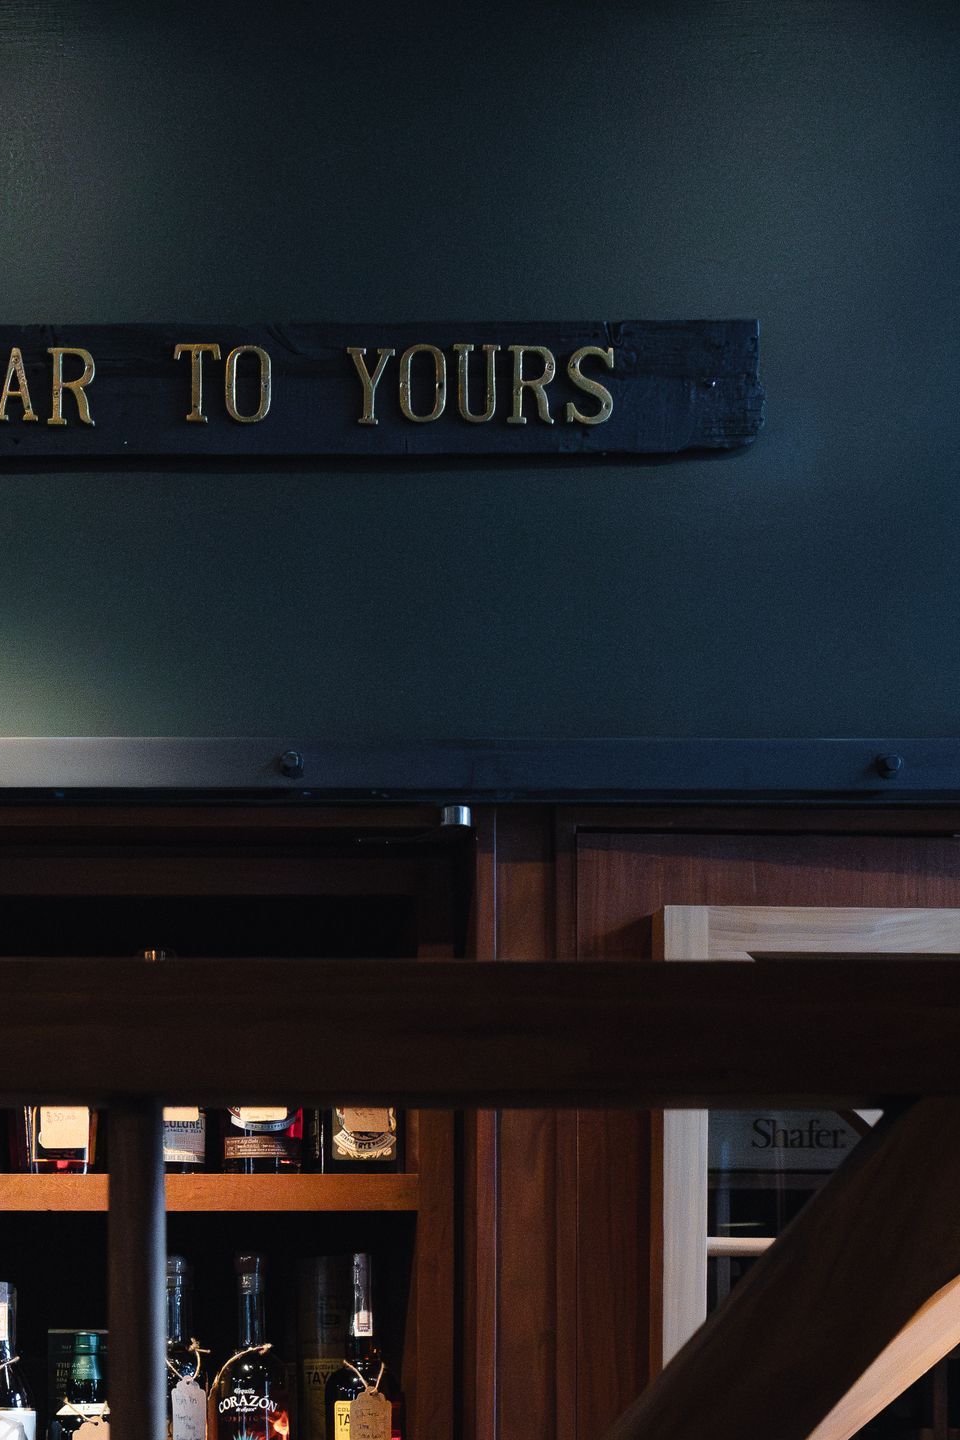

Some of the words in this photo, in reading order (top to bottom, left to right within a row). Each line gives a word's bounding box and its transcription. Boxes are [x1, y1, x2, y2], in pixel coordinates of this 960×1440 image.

[173, 343, 272, 423] TO
[346, 343, 614, 425] YOURS
[219, 1394, 278, 1414] CORAZÓN
